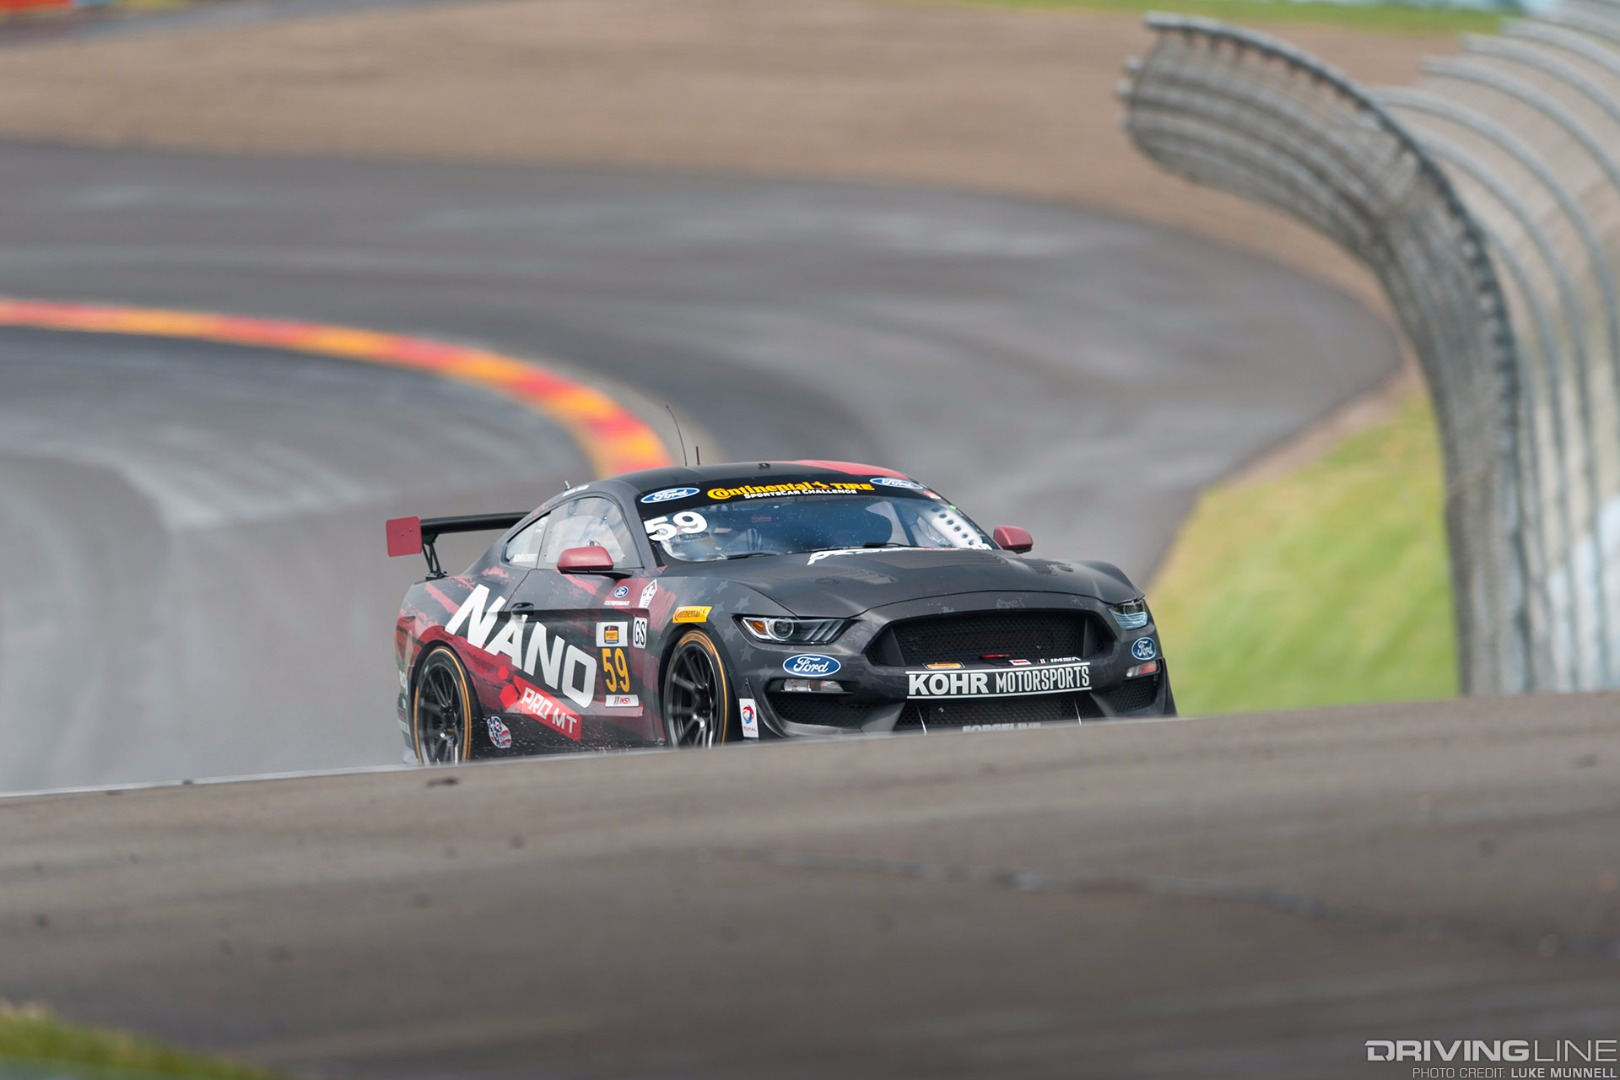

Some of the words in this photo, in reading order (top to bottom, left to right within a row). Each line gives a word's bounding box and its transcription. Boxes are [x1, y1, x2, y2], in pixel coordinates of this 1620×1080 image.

[652, 488, 689, 501] Ford
[707, 482, 812, 500] Continental
[830, 482, 875, 491] TIRE
[744, 489, 801, 499] SPORTSCAR
[802, 488, 857, 496] CHALLENGE
[643, 511, 708, 541] 59
[445, 583, 597, 709] NANO
[634, 620, 646, 646] GS
[1137, 639, 1155, 656] Ford
[601, 647, 631, 693] 59
[793, 656, 829, 672] Ford
[908, 672, 990, 696] KOHR
[995, 666, 1090, 694] MOTORSPORTS
[520, 686, 553, 720] PRO
[551, 707, 577, 734] MT
